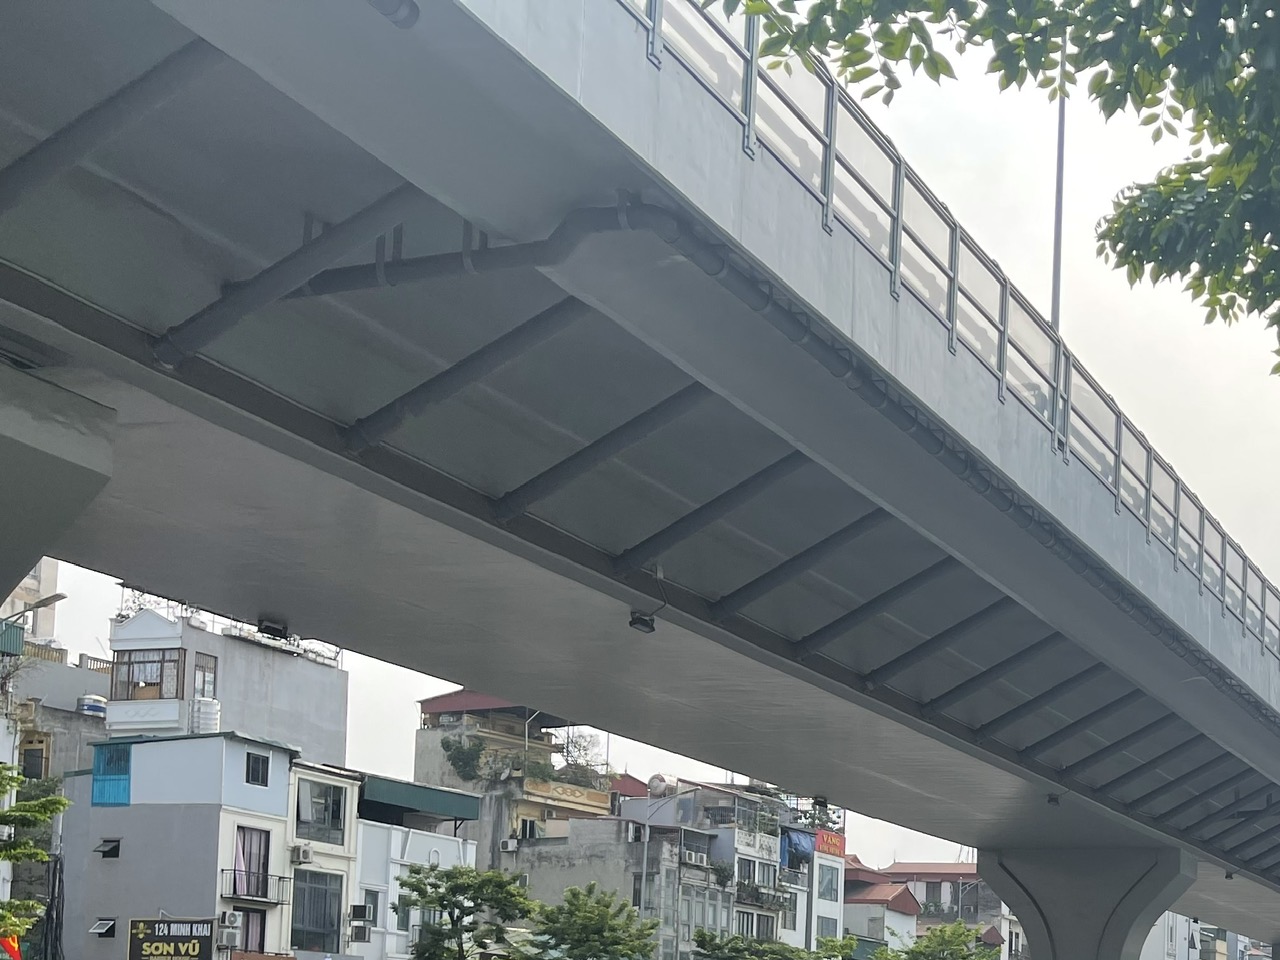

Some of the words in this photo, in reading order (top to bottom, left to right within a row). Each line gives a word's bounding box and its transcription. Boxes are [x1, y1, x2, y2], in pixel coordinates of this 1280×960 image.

[170, 923, 191, 936] MINH
[192, 923, 211, 936] KHAI
[178, 939, 200, 956] VŨ
